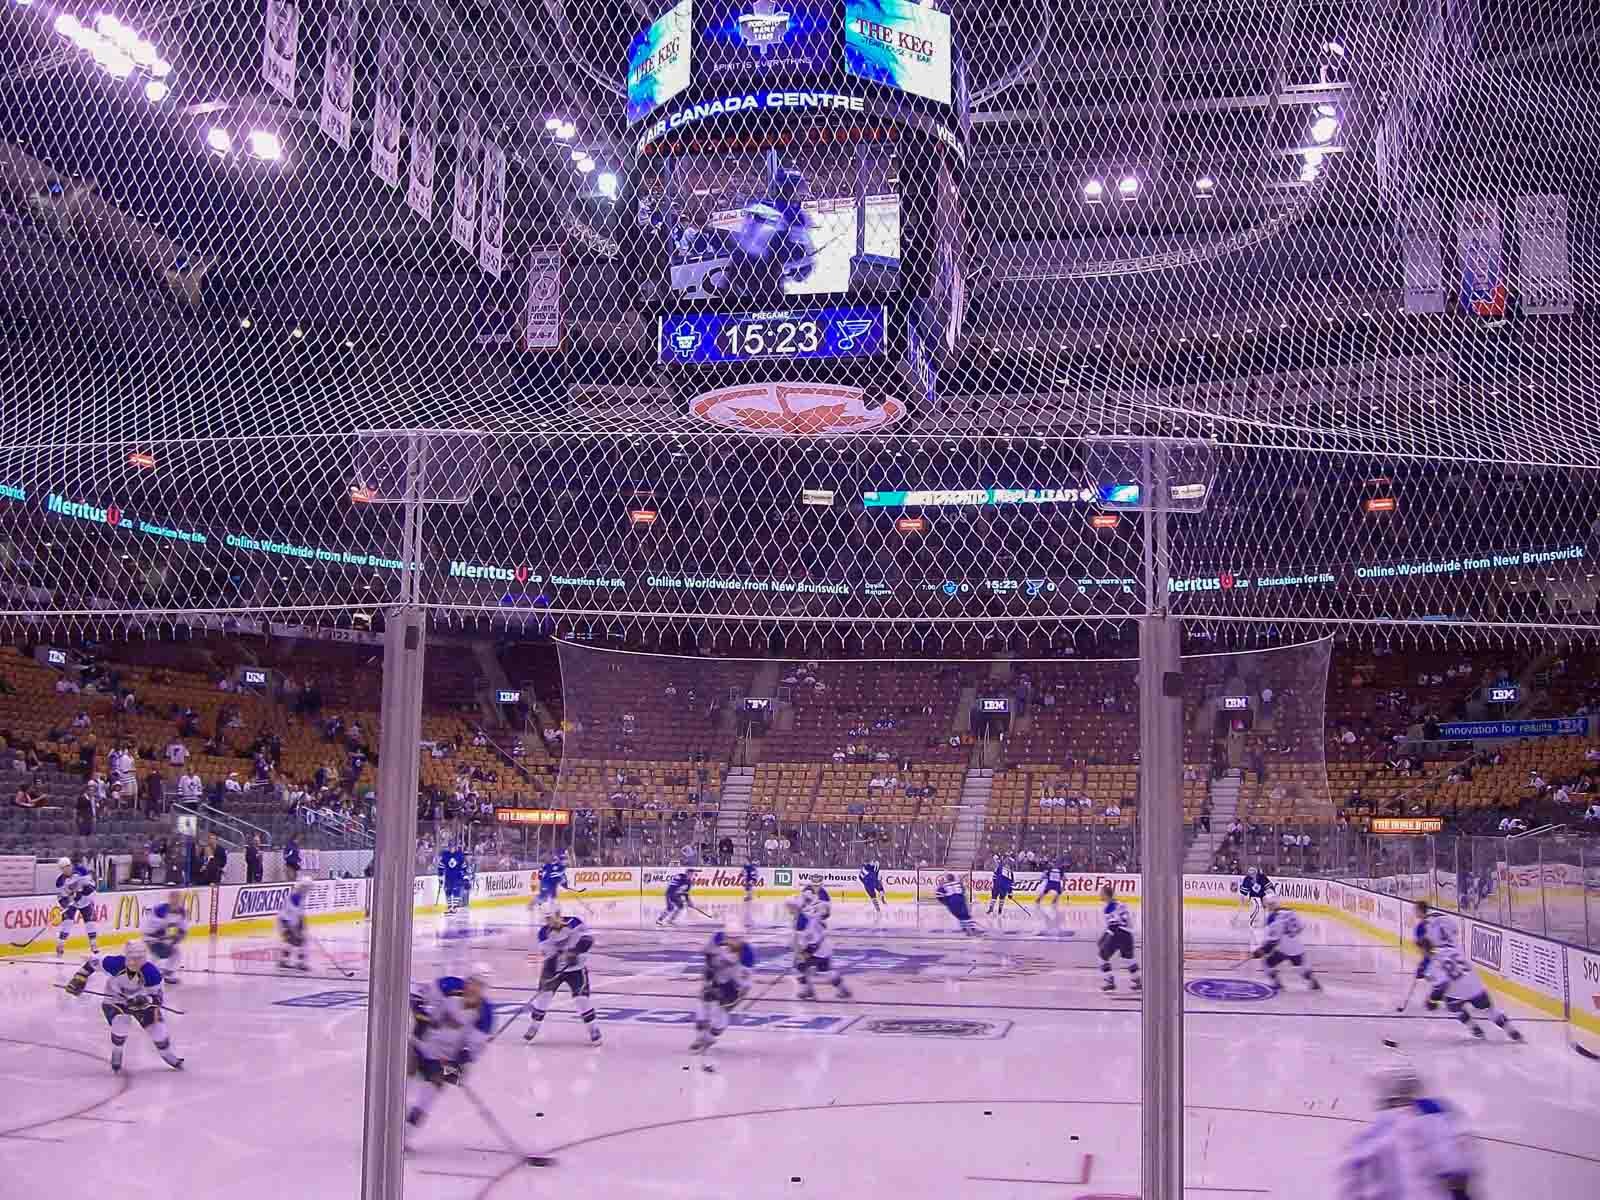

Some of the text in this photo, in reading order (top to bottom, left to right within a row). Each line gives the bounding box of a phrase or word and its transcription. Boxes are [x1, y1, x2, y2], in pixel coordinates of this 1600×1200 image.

[856, 17, 935, 57] THE KEG
[636, 55, 655, 81] THE
[658, 37, 680, 65] KEG
[647, 119, 667, 144] AIR
[669, 95, 759, 128] CANADA
[766, 92, 864, 111] CENTRE
[751, 311, 789, 320] PREGAME
[726, 321, 818, 354] 15:23
[139, 521, 177, 538] Education
[178, 529, 190, 541] for
[191, 532, 208, 544] life
[226, 534, 260, 550] Online
[260, 539, 313, 559] Worldwide
[315, 549, 341, 562] from
[343, 551, 367, 564] New
[1257, 575, 1302, 588] Education
[1304, 574, 1317, 586] for
[1319, 572, 1335, 585] life
[1357, 564, 1395, 579] Online
[1397, 560, 1461, 576] Worldwide
[1464, 557, 1490, 570] from
[1494, 554, 1520, 567] New
[1522, 545, 1584, 564] Brunswick
[551, 575, 595, 587] Education
[596, 576, 609, 587] for
[611, 577, 625, 589] life
[646, 576, 682, 588] Online
[684, 577, 741, 590] Worldwide
[745, 580, 768, 591] from
[771, 581, 795, 593] New
[797, 582, 849, 595] Brunswick
[985, 581, 1018, 589] 15:23
[500, 691, 520, 702] IBM
[1492, 689, 1514, 701] IBM
[984, 700, 1005, 711] IBM
[1225, 698, 1246, 709] IBM
[1445, 725, 1498, 736] innovation
[1501, 725, 1516, 733] for
[575, 870, 633, 885] pizza pizza
[775, 871, 791, 883] TD
[886, 874, 932, 886] CANADA
[1095, 876, 1136, 892] Farm
[1184, 880, 1225, 892] BRAVIA
[1274, 881, 1314, 901] CANADIAN
[237, 888, 290, 915] SNICKERS
